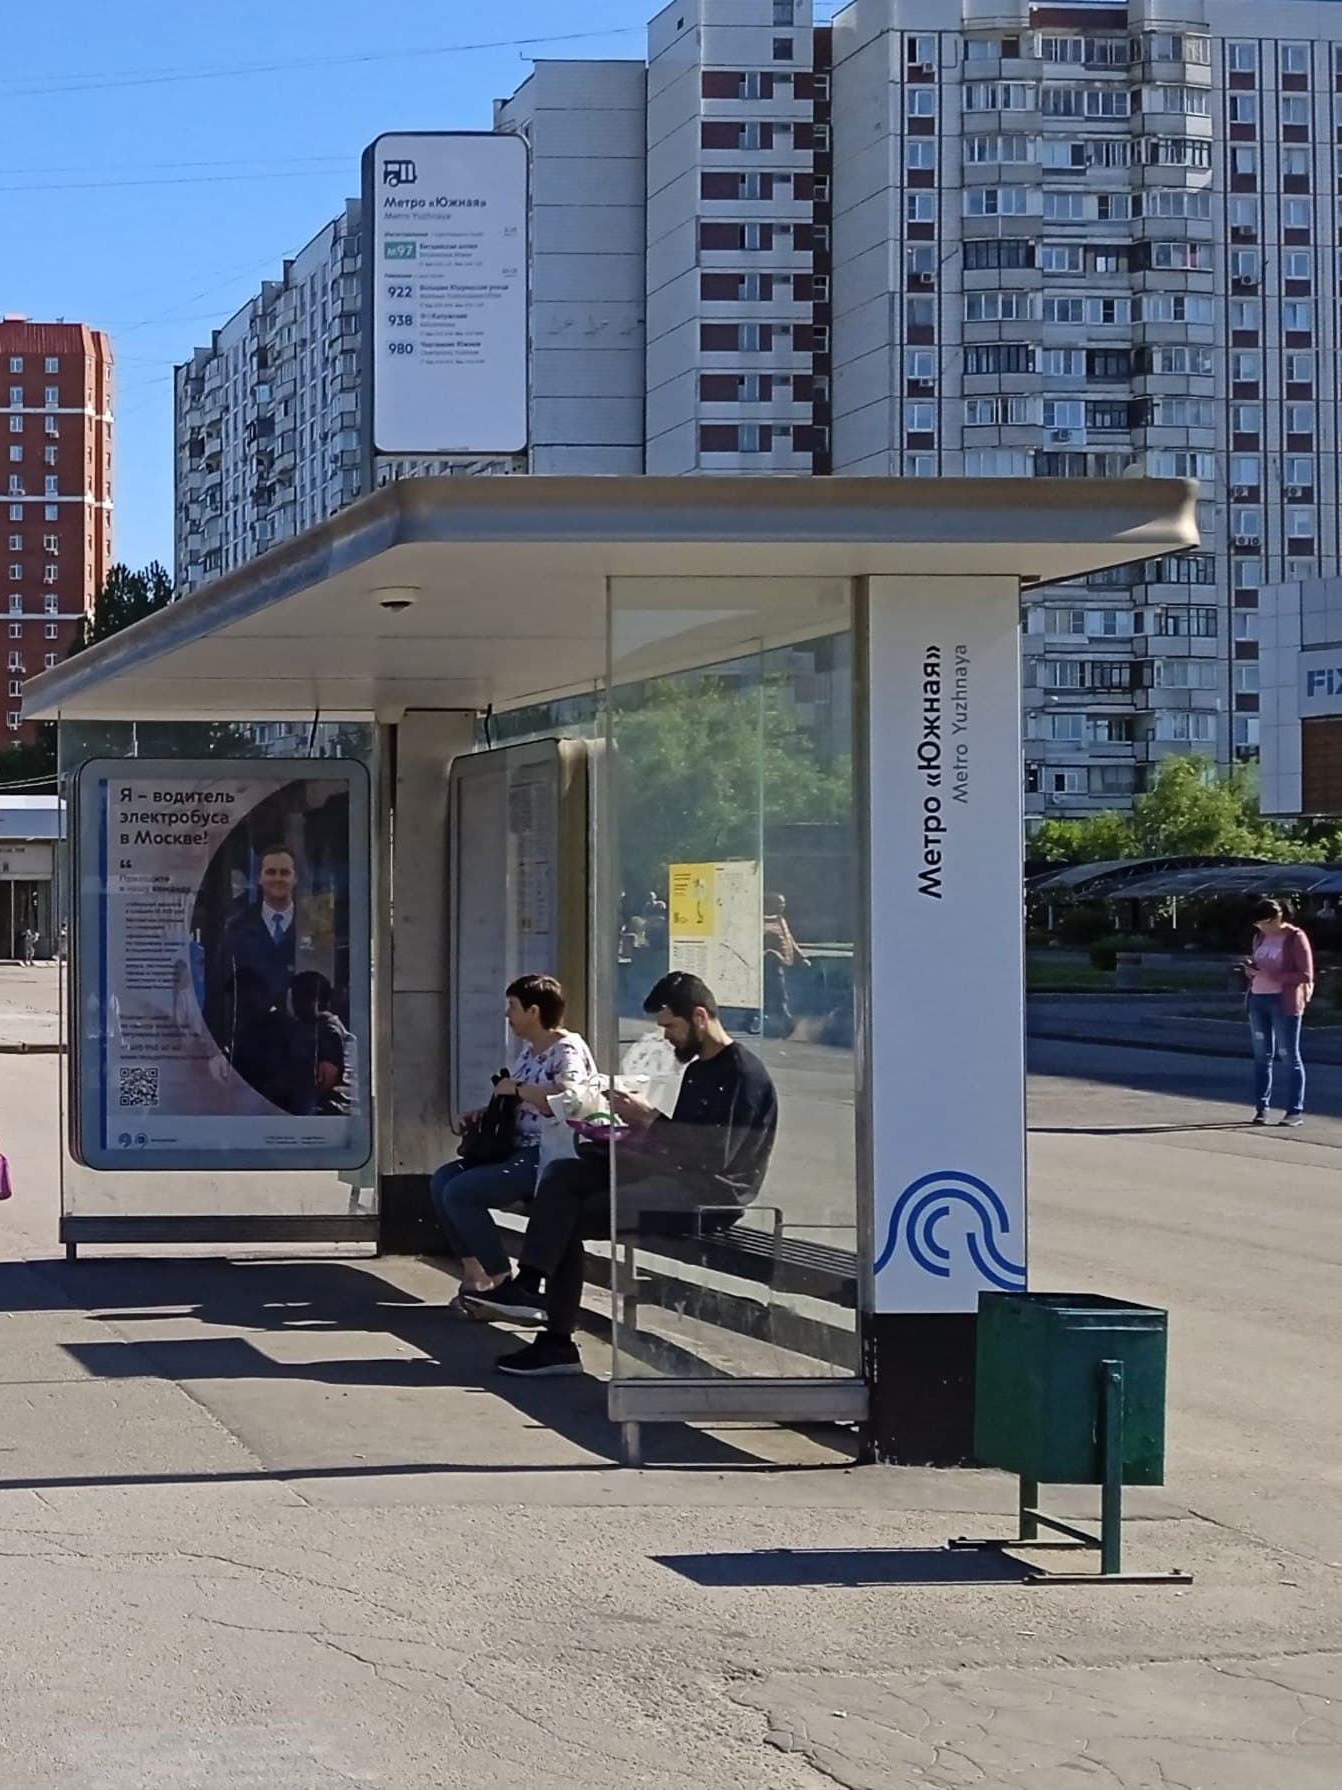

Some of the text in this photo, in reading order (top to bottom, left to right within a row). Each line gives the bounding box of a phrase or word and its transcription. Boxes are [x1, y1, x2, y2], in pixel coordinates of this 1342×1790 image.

[384, 196, 487, 209] Метро «Южная»
[388, 286, 413, 298] 922
[388, 314, 413, 326] 938
[388, 343, 414, 354] 980
[951, 644, 970, 804] Metro Yuzhnaya
[917, 645, 947, 899] Метро «Южная»
[120, 788, 132, 802] Я
[153, 791, 235, 804] водитель
[120, 810, 229, 827] электробуса
[120, 830, 208, 845] в Москве!
